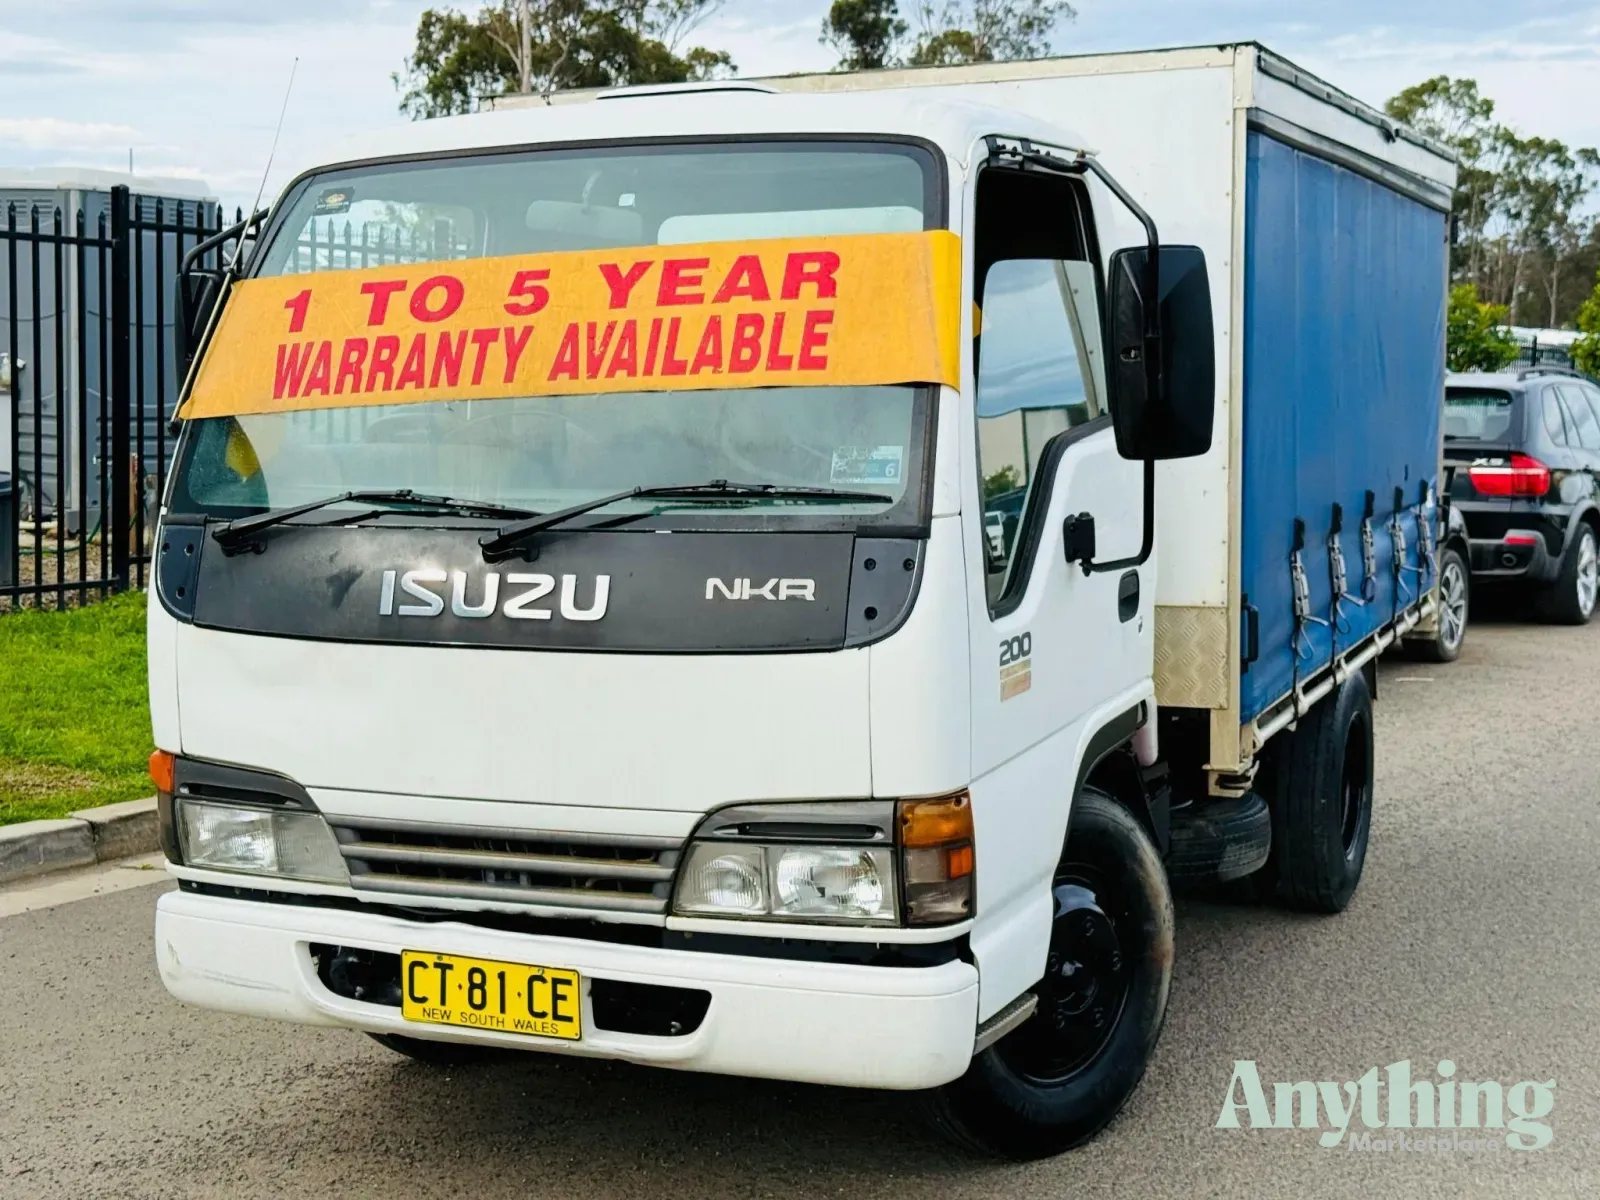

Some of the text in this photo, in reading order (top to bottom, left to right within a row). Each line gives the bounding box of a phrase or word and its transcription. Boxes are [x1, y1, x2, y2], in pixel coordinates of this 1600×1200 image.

[284, 251, 840, 333] 1 TO 5 YEAR
[272, 309, 835, 400] WARRANTY AVAILABLE
[885, 462, 896, 477] 6
[379, 569, 610, 621] ISUZU
[705, 577, 815, 601] NKR
[999, 631, 1032, 667] 200
[422, 1007, 559, 1035] NEW SOUTH WALES
